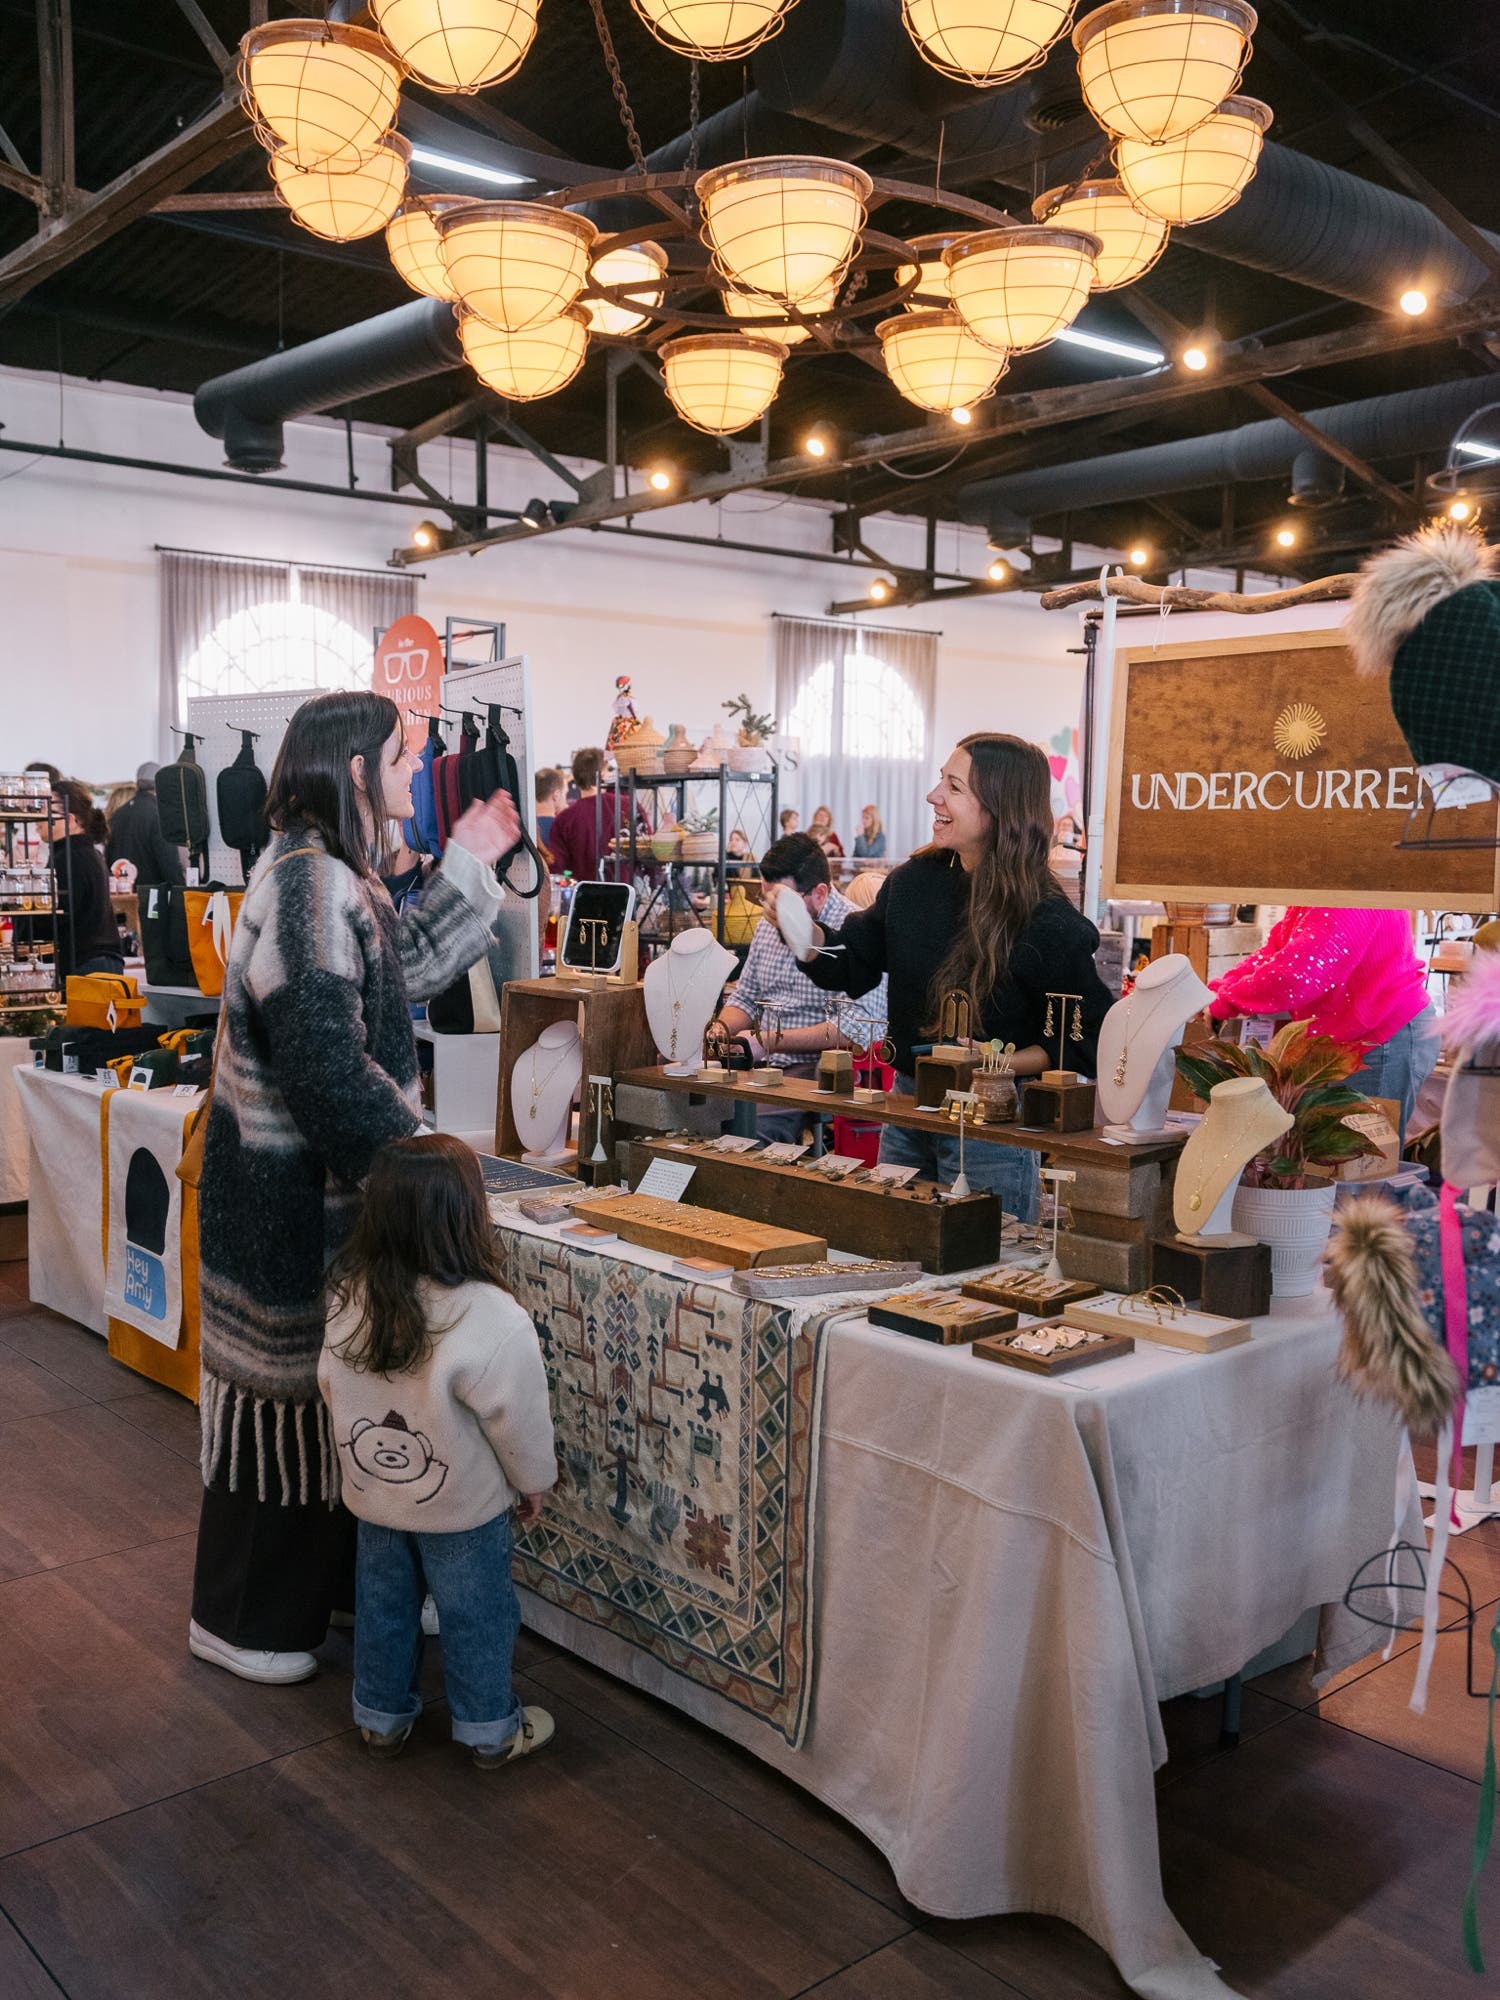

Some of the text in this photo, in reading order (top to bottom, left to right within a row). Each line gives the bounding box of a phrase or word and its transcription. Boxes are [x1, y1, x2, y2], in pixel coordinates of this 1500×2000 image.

[381, 685, 432, 703] URIOUS
[1131, 767, 1467, 811] UNDERCURREN
[127, 1249, 149, 1284] Hey
[126, 1273, 153, 1311] Amy
